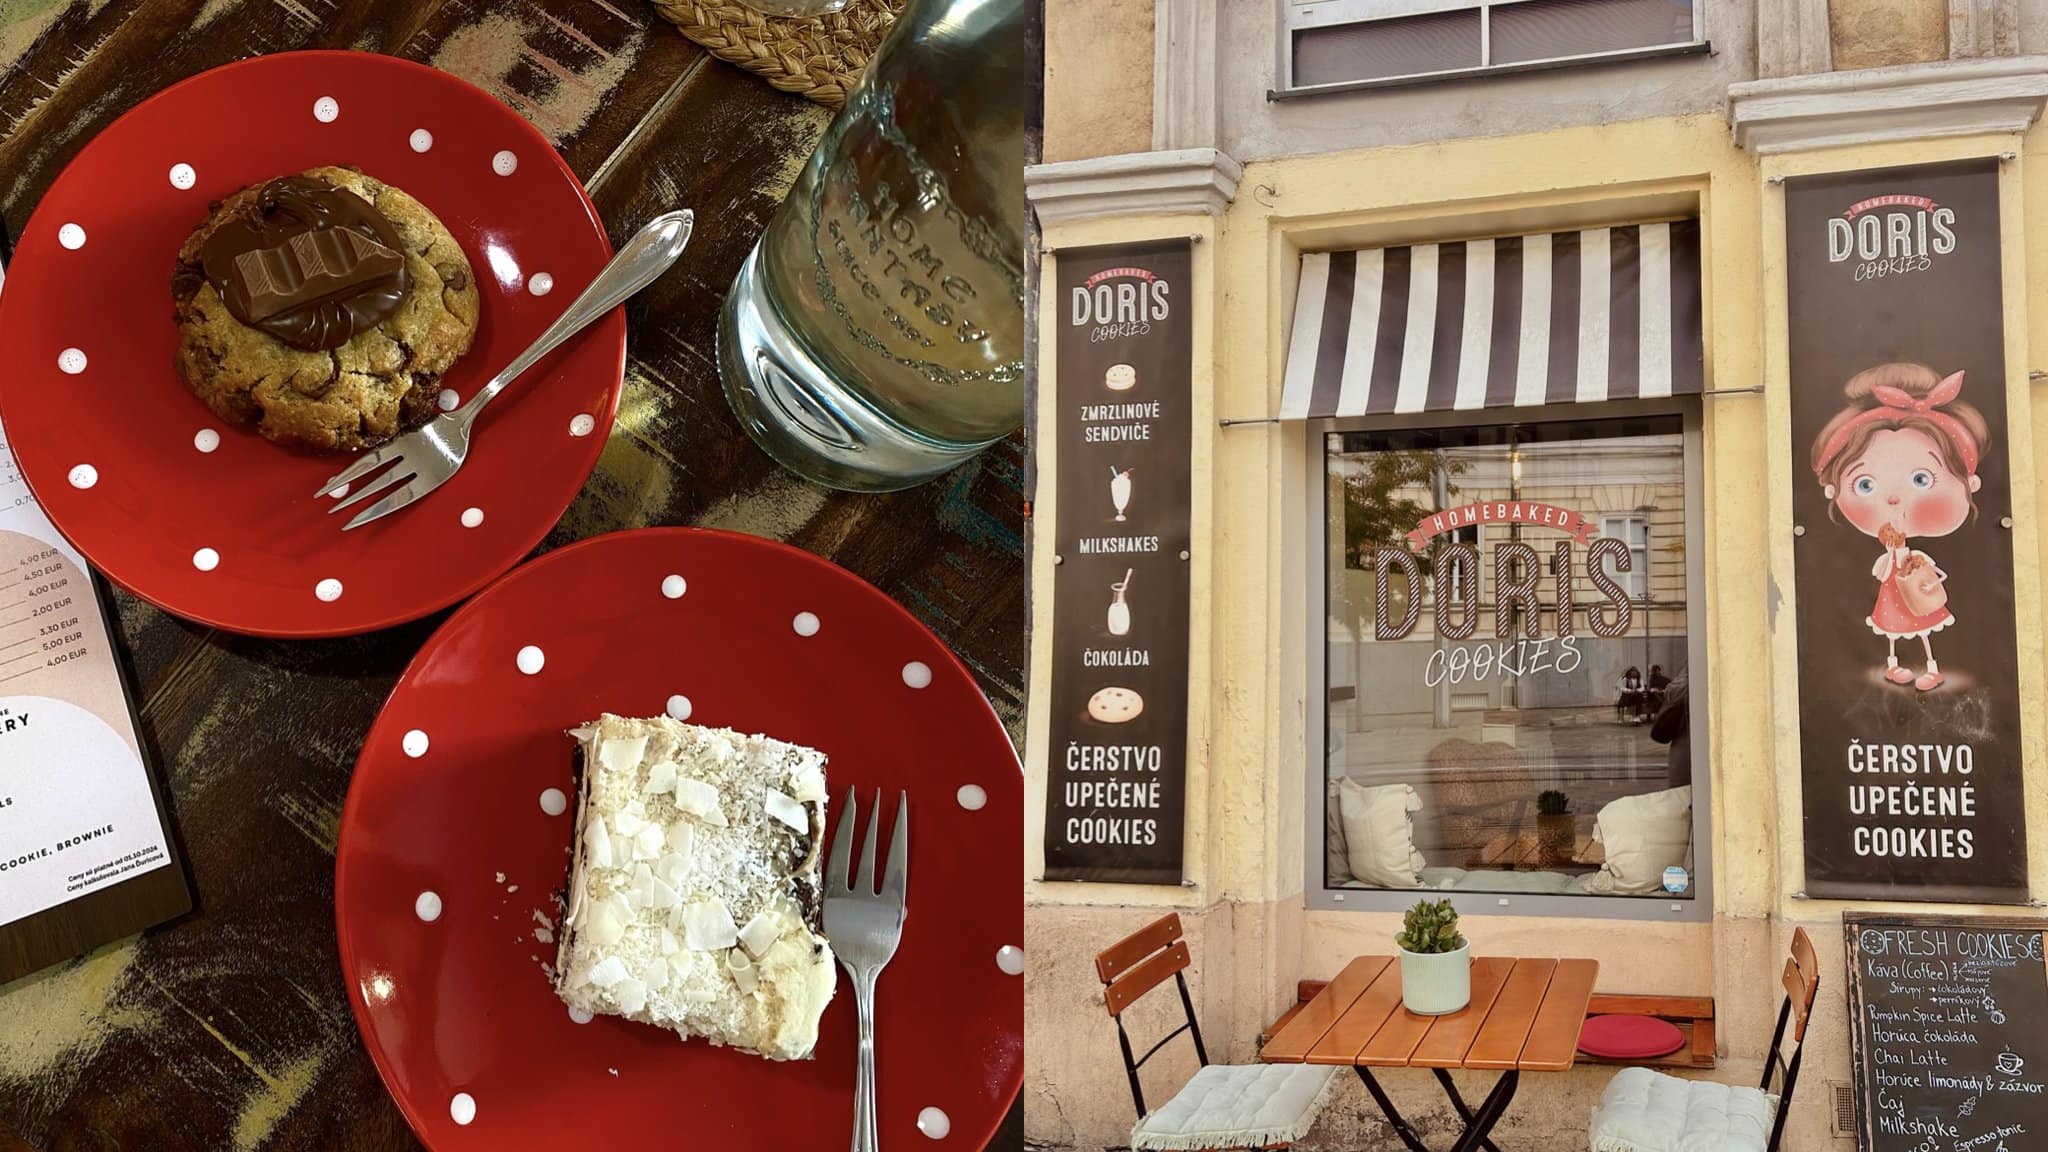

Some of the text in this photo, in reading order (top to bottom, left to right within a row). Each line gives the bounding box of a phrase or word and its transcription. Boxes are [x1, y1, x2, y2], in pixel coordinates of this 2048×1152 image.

[1828, 207, 1956, 263] DORIS
[1855, 254, 1932, 281] COOKIES
[1072, 280, 1169, 326] DORIS
[1090, 319, 1151, 343] COOKIES
[1081, 400, 1160, 421] ZMRZLINOVÉ
[1085, 422, 1150, 443] SENDVIČE
[1432, 503, 1569, 532] HOMEBAKED
[41, 548, 58, 559] EUR
[1079, 536, 1159, 554] MILKSHAKES
[45, 563, 63, 574] EUR
[50, 578, 68, 590] EUR
[1374, 537, 1633, 642] DORIS
[54, 597, 72, 609] EUR
[61, 617, 78, 629] EUR
[65, 631, 82, 643] EUR
[69, 647, 87, 660] EUR
[1083, 648, 1150, 667] ČOKOLÁDA
[1424, 635, 1582, 688] COOKIES
[1066, 740, 1161, 772] ČERSTVO
[1848, 738, 1974, 774] ČERSTVO
[1065, 777, 1161, 809] UPEČENÉ
[1849, 780, 1976, 817] UPEČENÉ
[56, 824, 114, 851] BROWNIE
[1066, 818, 1157, 846] COOKIES
[1854, 826, 1974, 859] COOKIES
[67, 882, 83, 892] Ceny
[120, 863, 135, 873] Jana
[68, 872, 84, 882] Ceny
[1884, 930, 2030, 959] FRESH COOKIES
[1867, 959, 1899, 978] Káva
[1901, 959, 1949, 980] (Coffee)
[1867, 1004, 1978, 1025] Pumpkin Spice Latte
[1872, 1024, 1978, 1044] Horúca čokoláda
[1874, 1048, 1948, 1066] Chai Latte
[1875, 1069, 2045, 1097] Horúce limonády & zázvor
[1878, 1088, 1905, 1118] Čaj
[1879, 1115, 1960, 1138] Milkshake
[1953, 1123, 2026, 1152] Espresso tonic
